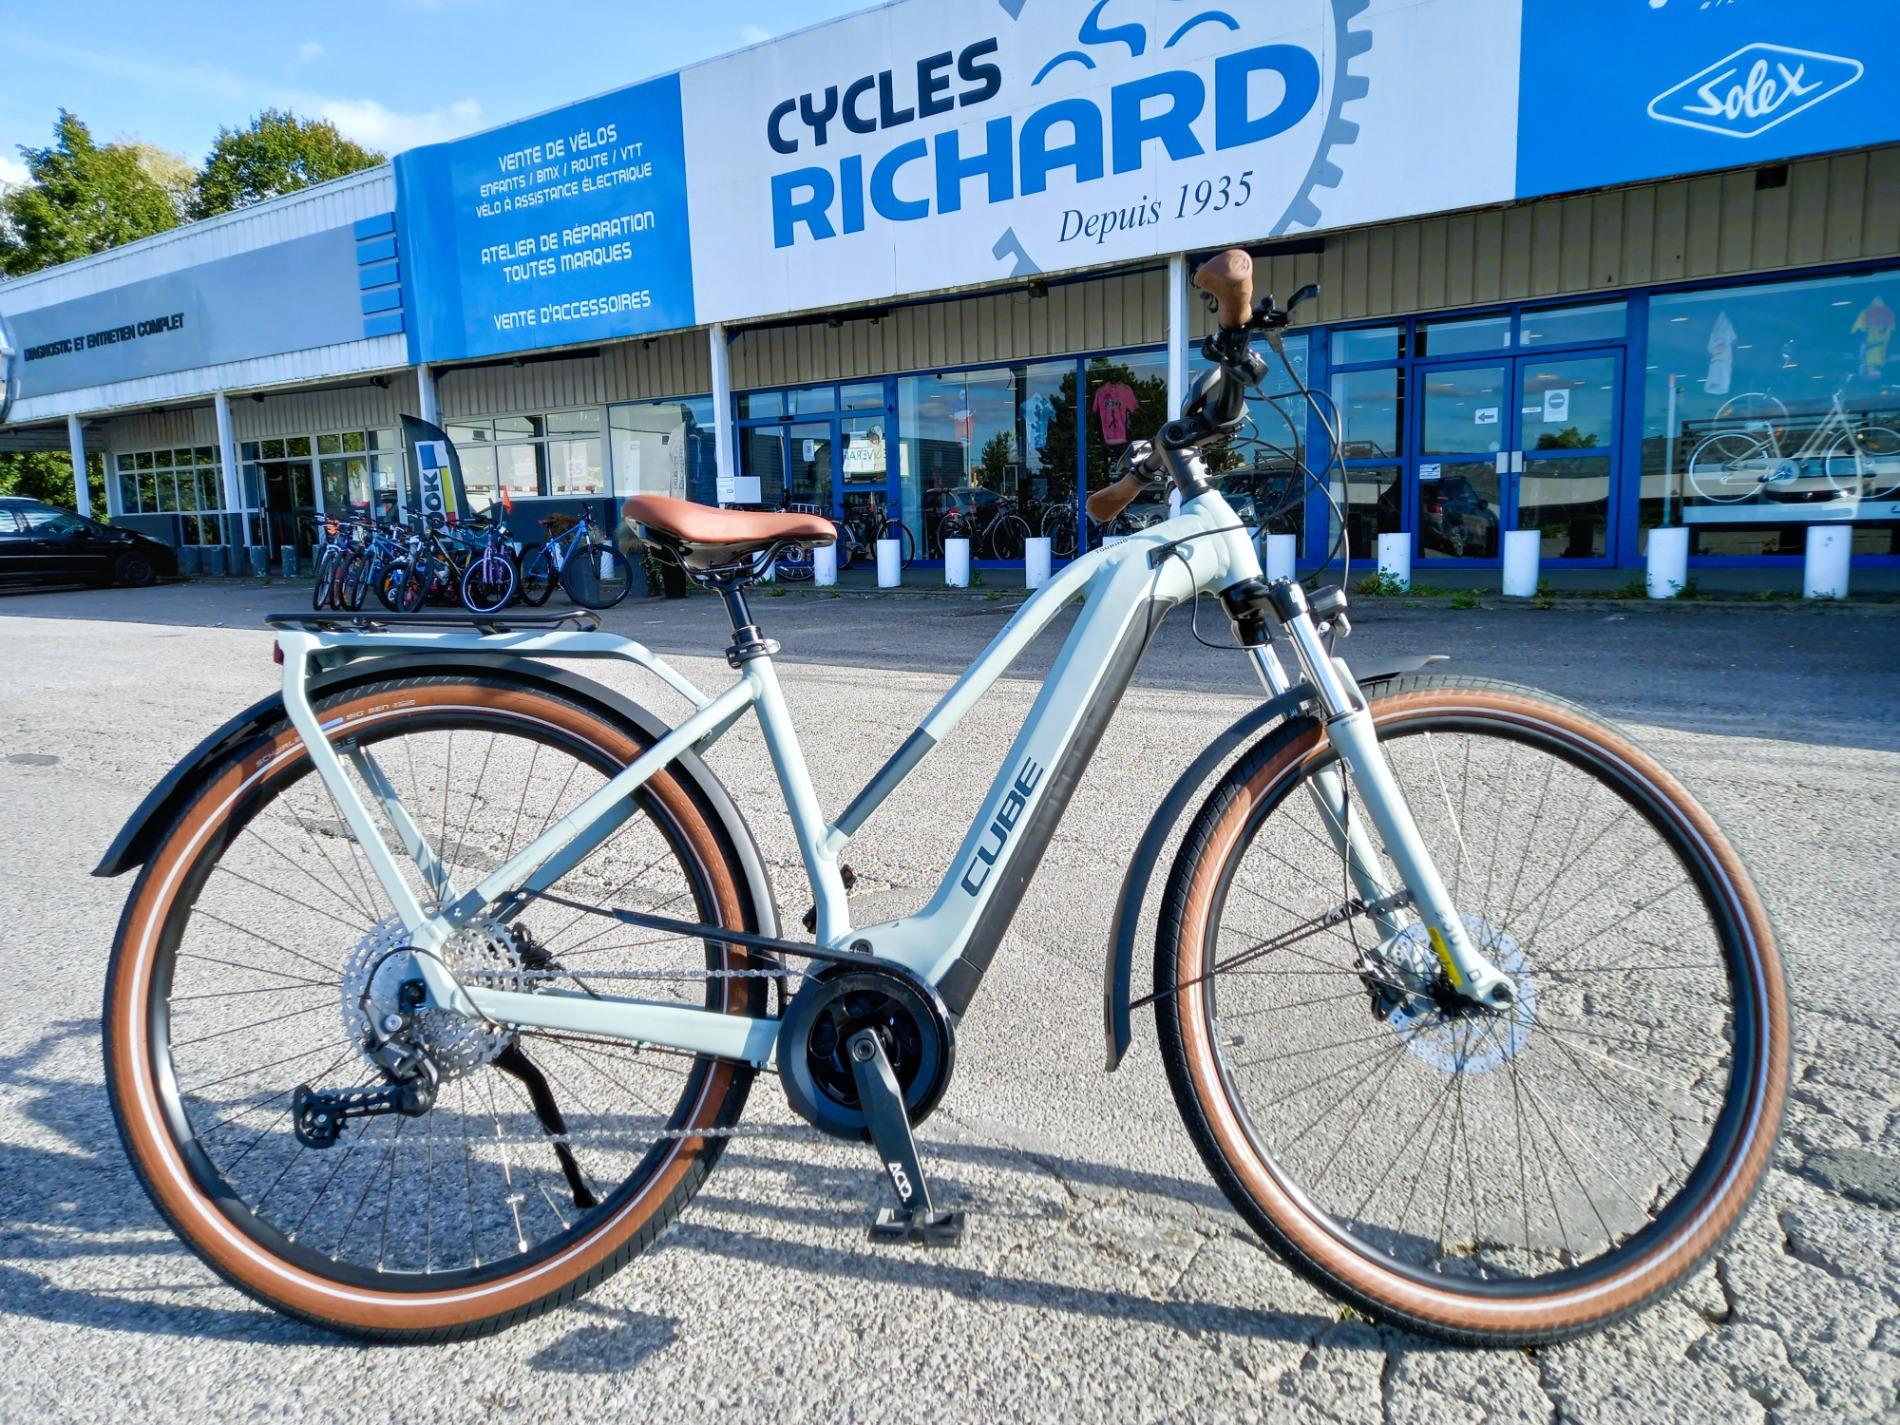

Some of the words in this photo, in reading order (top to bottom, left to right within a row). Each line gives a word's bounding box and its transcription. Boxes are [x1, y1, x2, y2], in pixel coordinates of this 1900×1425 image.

[767, 37, 1001, 154] CYCLES
[1682, 59, 1823, 120] Solex
[480, 175, 526, 197] ENFANTS
[536, 166, 560, 183] BMX
[571, 152, 609, 175] ROUTE
[620, 142, 643, 161] VTT
[498, 145, 542, 172] VENTE
[546, 139, 565, 160] DE
[568, 124, 618, 151] VÉLOS
[770, 43, 1321, 249] RICHARD
[475, 201, 501, 218] VÉLO
[504, 195, 512, 211] À
[514, 181, 579, 209] ASSISTANCE
[582, 162, 652, 192] ÉLECTRIQUE
[1057, 195, 1162, 245] Depuis
[1174, 170, 1254, 219] 1935
[481, 238, 536, 265] ATELIER
[540, 232, 558, 251] DE
[562, 211, 655, 246] RÉPARATION
[503, 258, 556, 283] TOUTES
[561, 241, 632, 272] MARQUES
[24, 339, 73, 362] DIAGNOSTIC
[73, 336, 86, 351] ET
[86, 324, 136, 349] ENTRETIEN
[137, 312, 185, 337] COMPLET
[494, 309, 537, 330] VENTE
[540, 289, 651, 324] D'ACCESSOIRES
[961, 756, 1044, 897] CUBE
